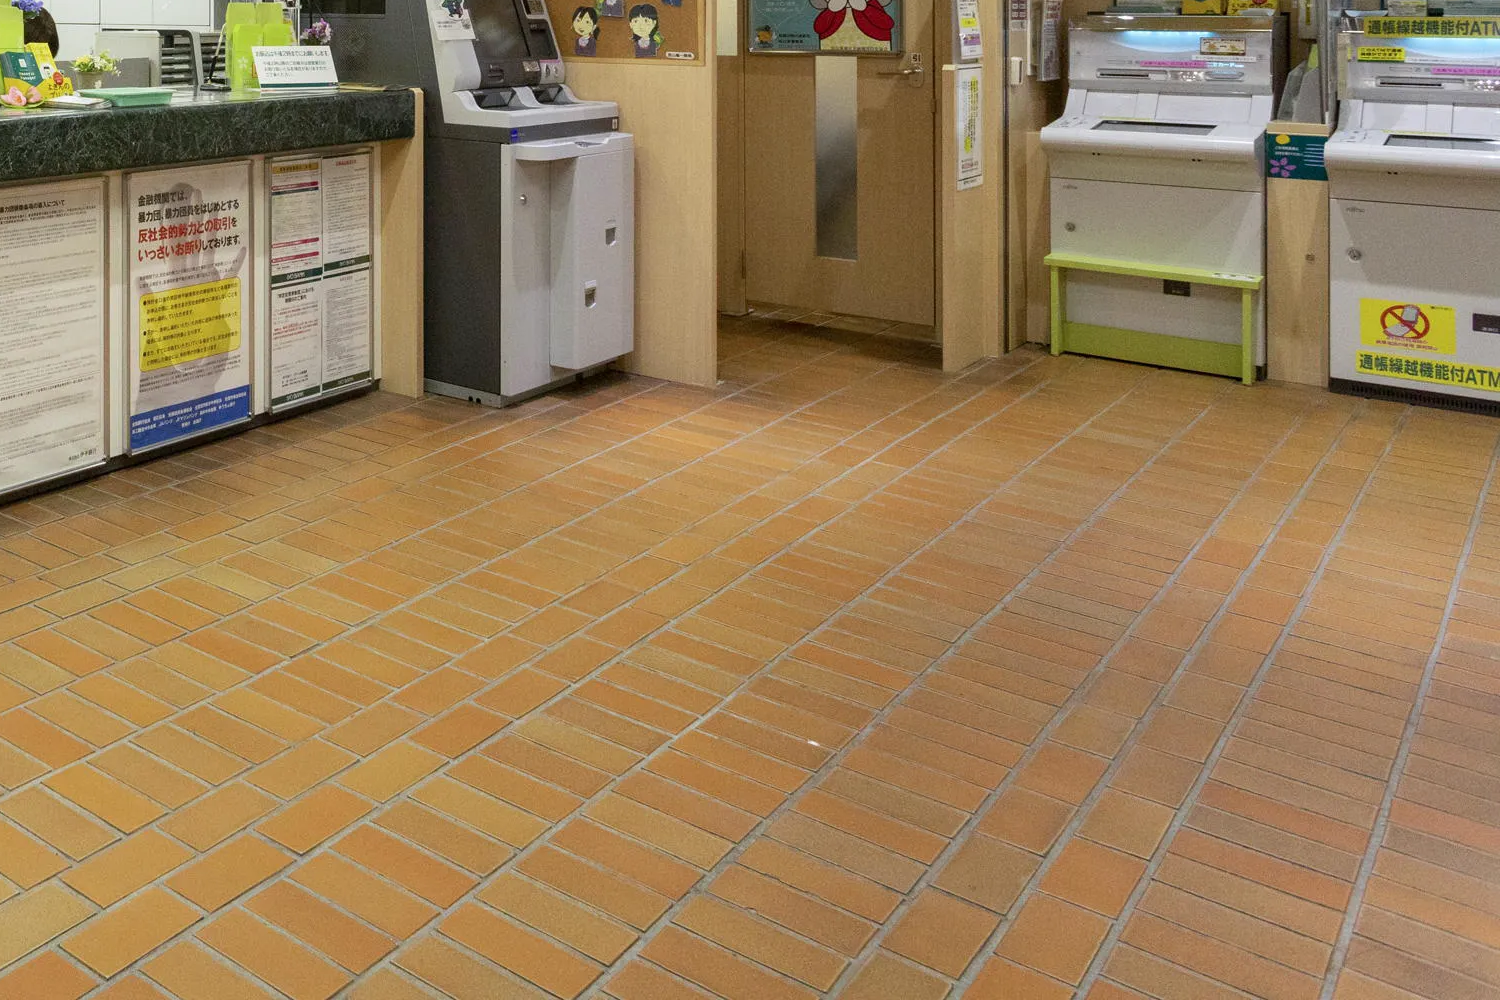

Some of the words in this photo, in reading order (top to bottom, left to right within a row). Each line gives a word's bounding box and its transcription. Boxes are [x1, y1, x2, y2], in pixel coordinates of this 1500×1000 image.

[138, 191, 188, 207] 金融機関では、
[138, 199, 240, 223] 暴力団、暴力団員をはじめとする
[138, 216, 238, 243] 反社会的勢力との取引を
[138, 235, 241, 263] いっさいお断りしております。
[1359, 353, 1500, 388] 通帳繰越機能付ATM
